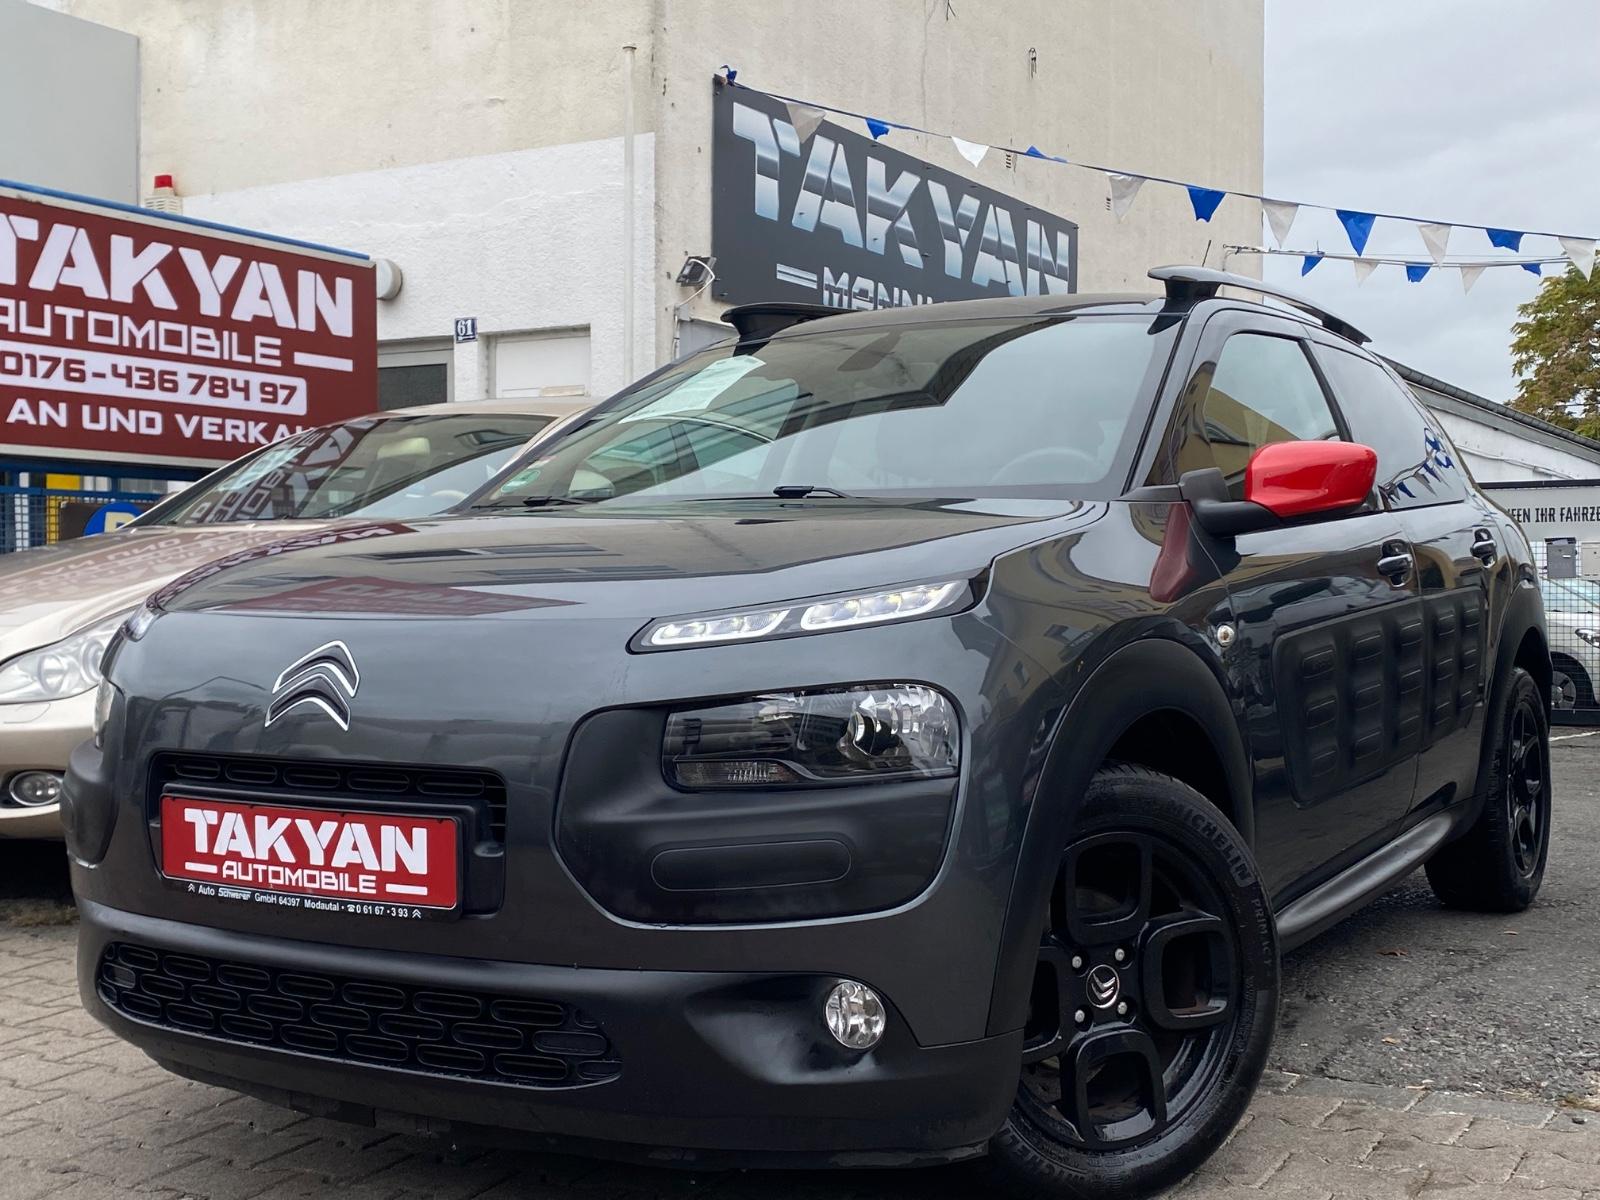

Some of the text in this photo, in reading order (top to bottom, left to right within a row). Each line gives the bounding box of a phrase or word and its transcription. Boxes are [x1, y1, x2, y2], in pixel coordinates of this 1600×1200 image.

[733, 102, 1070, 297] TAKYAN
[0, 213, 353, 338] TAKYAN
[0, 297, 282, 367] AUTOMOBILE
[457, 319, 473, 336] 61
[187, 372, 251, 401] 784
[260, 381, 297, 406] 97
[6, 398, 314, 446] AN UND VERKA
[1535, 507, 1556, 523] IHR
[184, 807, 428, 875] TAKYAN
[1167, 799, 1254, 882] MICHELIN
[198, 885, 216, 896] Auto
[254, 892, 277, 904] GmbH
[278, 896, 300, 907] 64397
[304, 899, 340, 912] Modautal
[222, 860, 377, 894] AUTOMOBILE
